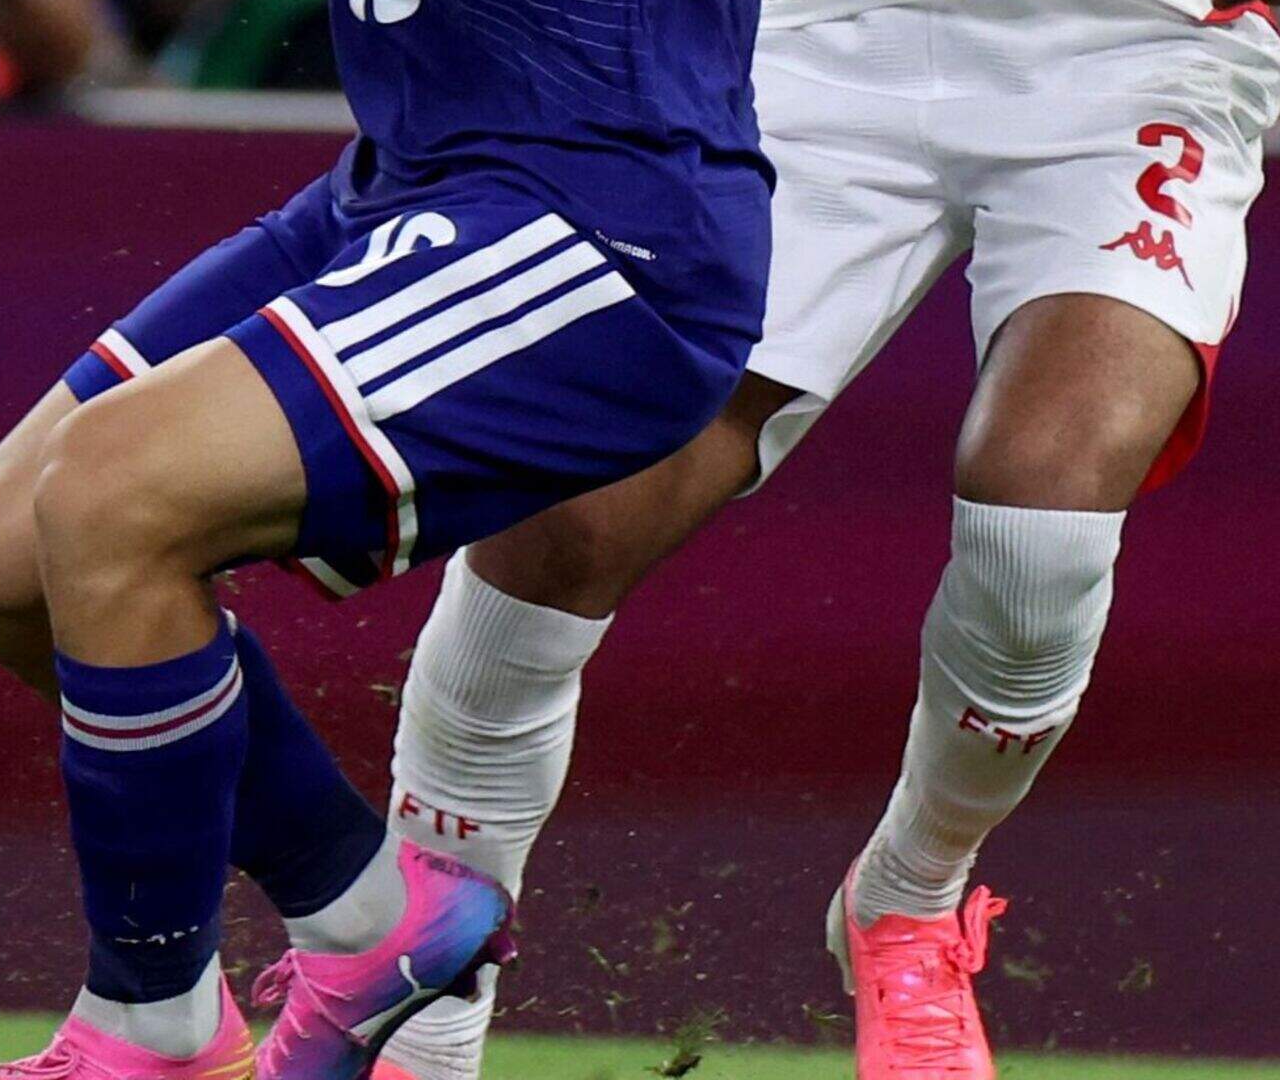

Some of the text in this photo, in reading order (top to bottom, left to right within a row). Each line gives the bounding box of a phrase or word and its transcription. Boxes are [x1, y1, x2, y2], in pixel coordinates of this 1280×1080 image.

[1135, 122, 1205, 230] 2
[959, 706, 1057, 754] FTF
[399, 792, 480, 840] FTF
